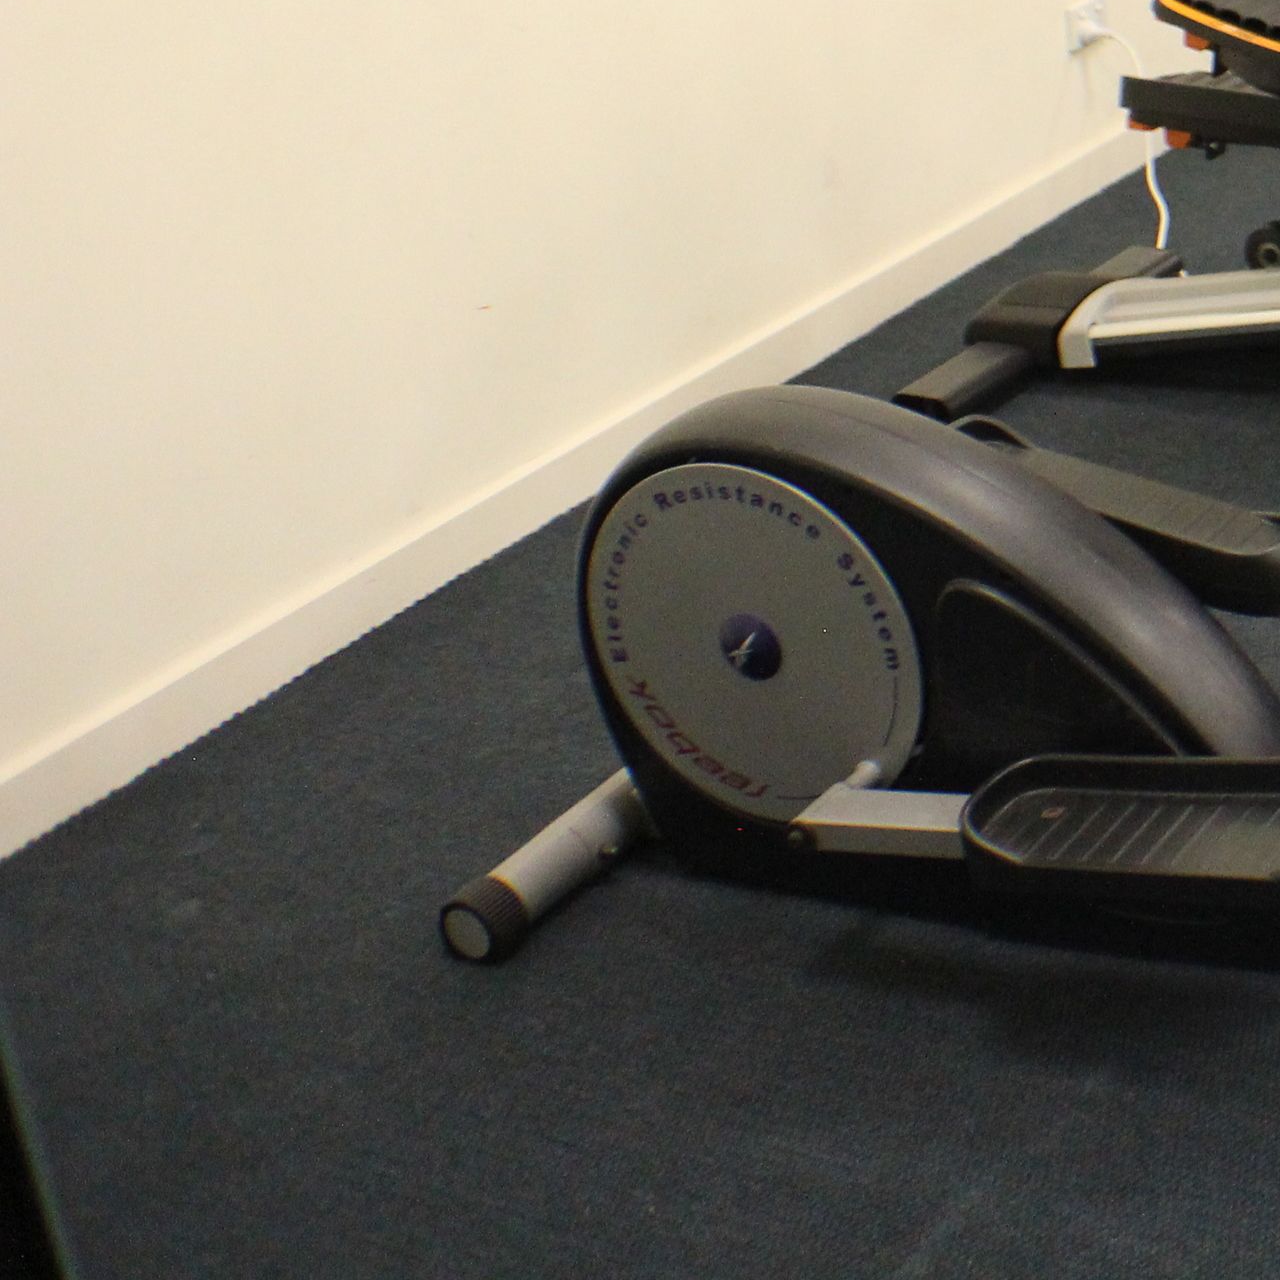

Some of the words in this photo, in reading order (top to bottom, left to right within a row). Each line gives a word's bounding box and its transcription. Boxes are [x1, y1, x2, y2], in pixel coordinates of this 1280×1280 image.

[602, 513, 648, 662] Electronic
[654, 482, 820, 539] Resistance
[836, 552, 899, 669] System
